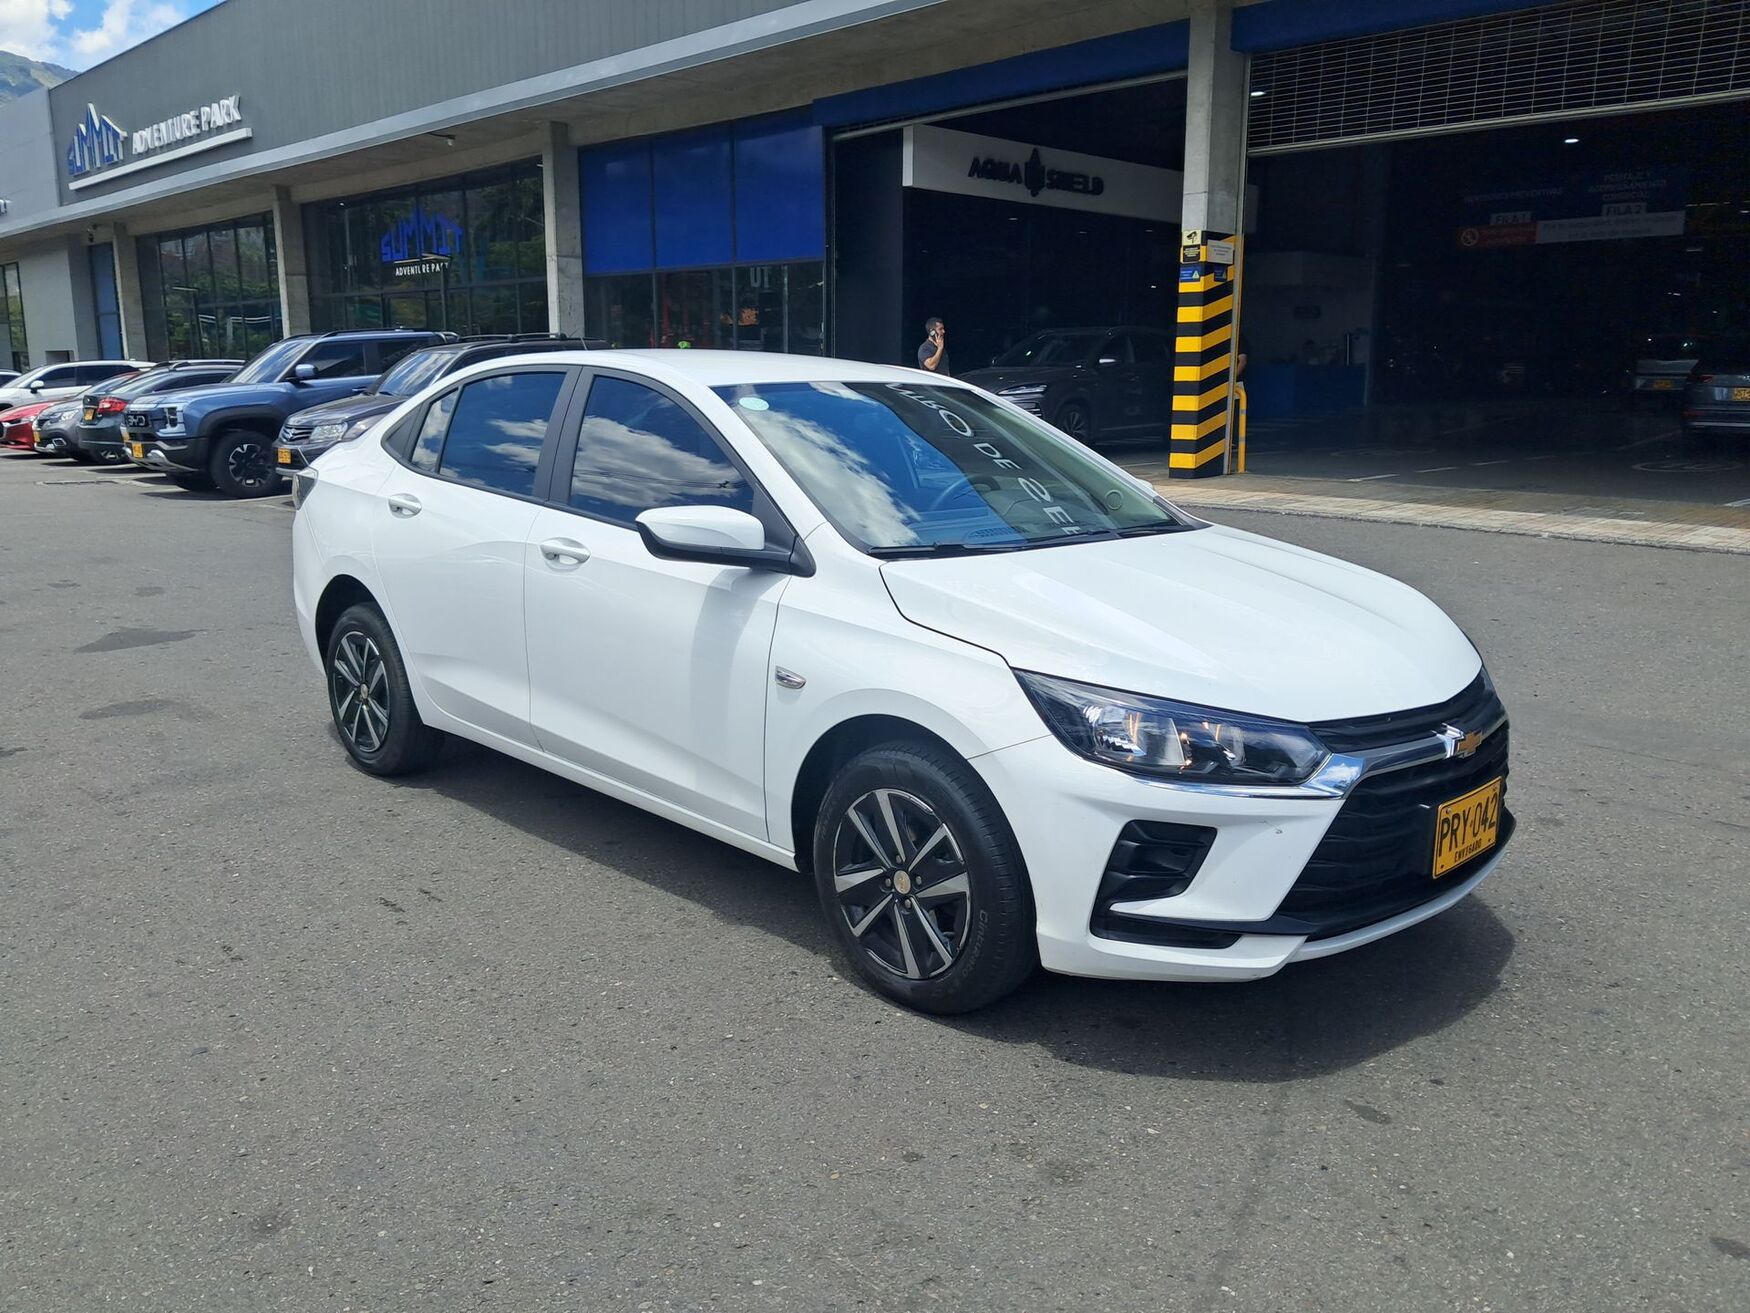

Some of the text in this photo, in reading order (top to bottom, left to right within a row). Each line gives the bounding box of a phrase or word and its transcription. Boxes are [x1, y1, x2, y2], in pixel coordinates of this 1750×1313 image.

[68, 103, 128, 176] SUMMIT
[132, 96, 242, 154] ADVENTURE PARK
[381, 207, 465, 264] SUMMIT
[1454, 838, 1482, 862] ENVIGADO
